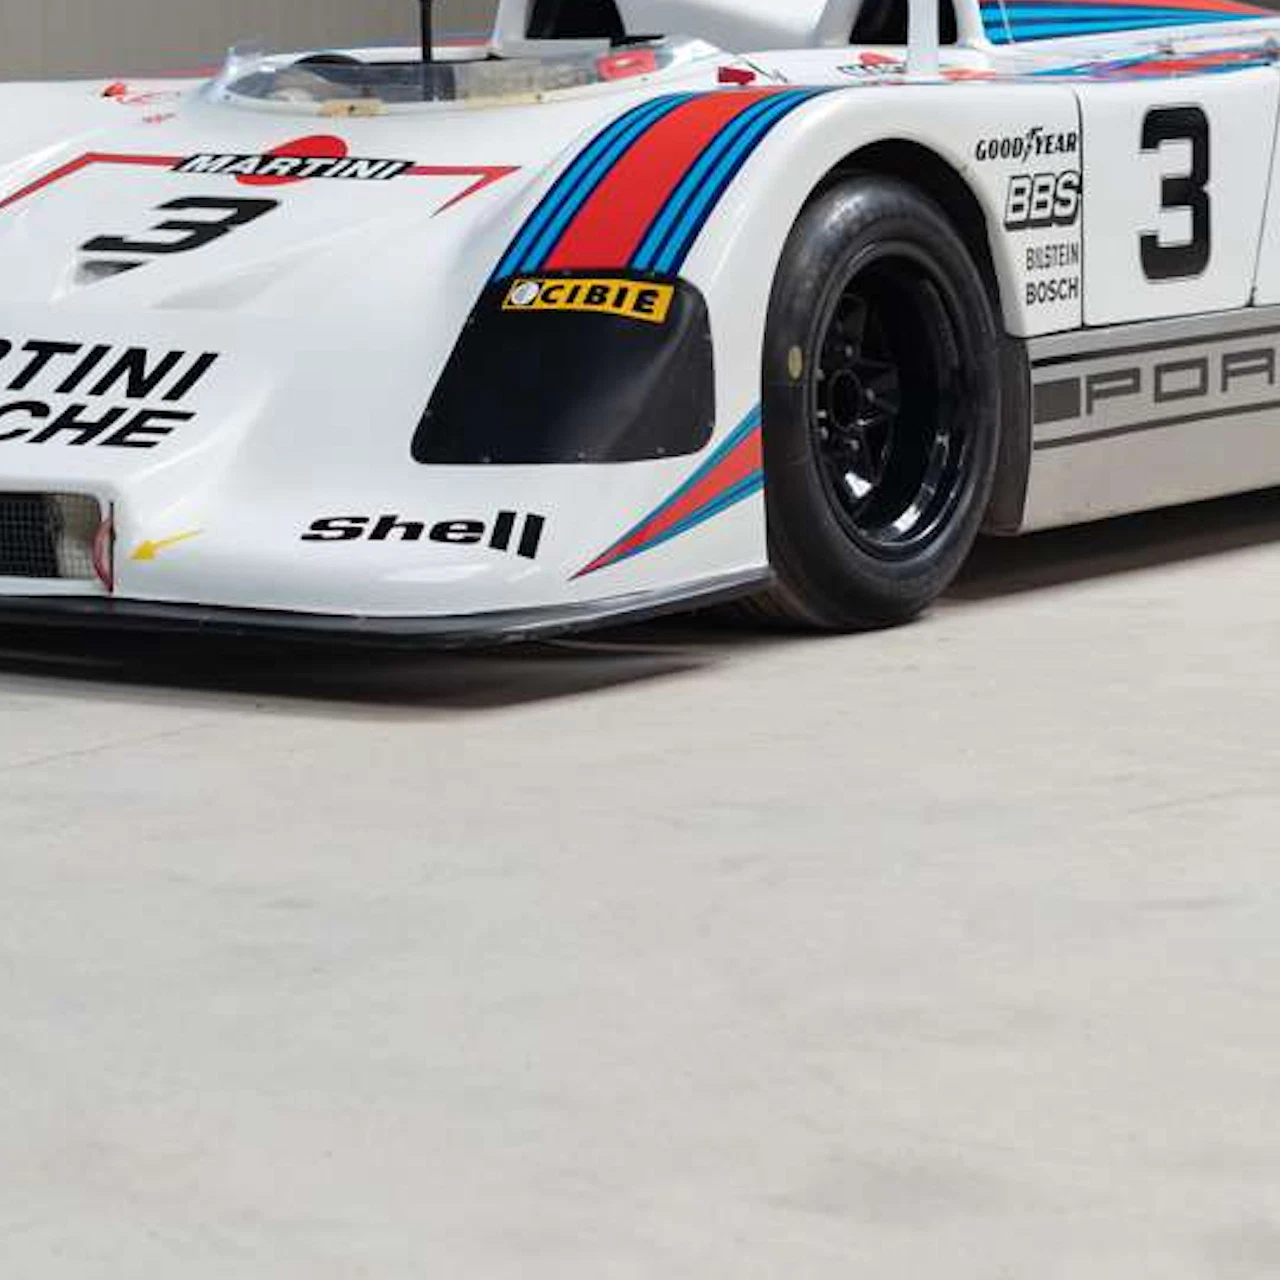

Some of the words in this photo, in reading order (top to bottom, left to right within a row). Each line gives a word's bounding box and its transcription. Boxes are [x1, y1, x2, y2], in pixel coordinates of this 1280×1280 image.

[975, 126, 1078, 162] GOODYEAR
[180, 155, 406, 180] MARTINI
[1003, 170, 1082, 232] BBS
[1138, 105, 1212, 280] 3
[79, 196, 281, 253] 3
[1025, 242, 1079, 271] BILSTEIN
[1025, 276, 1079, 306] BOSCH
[300, 510, 546, 560] Shell
